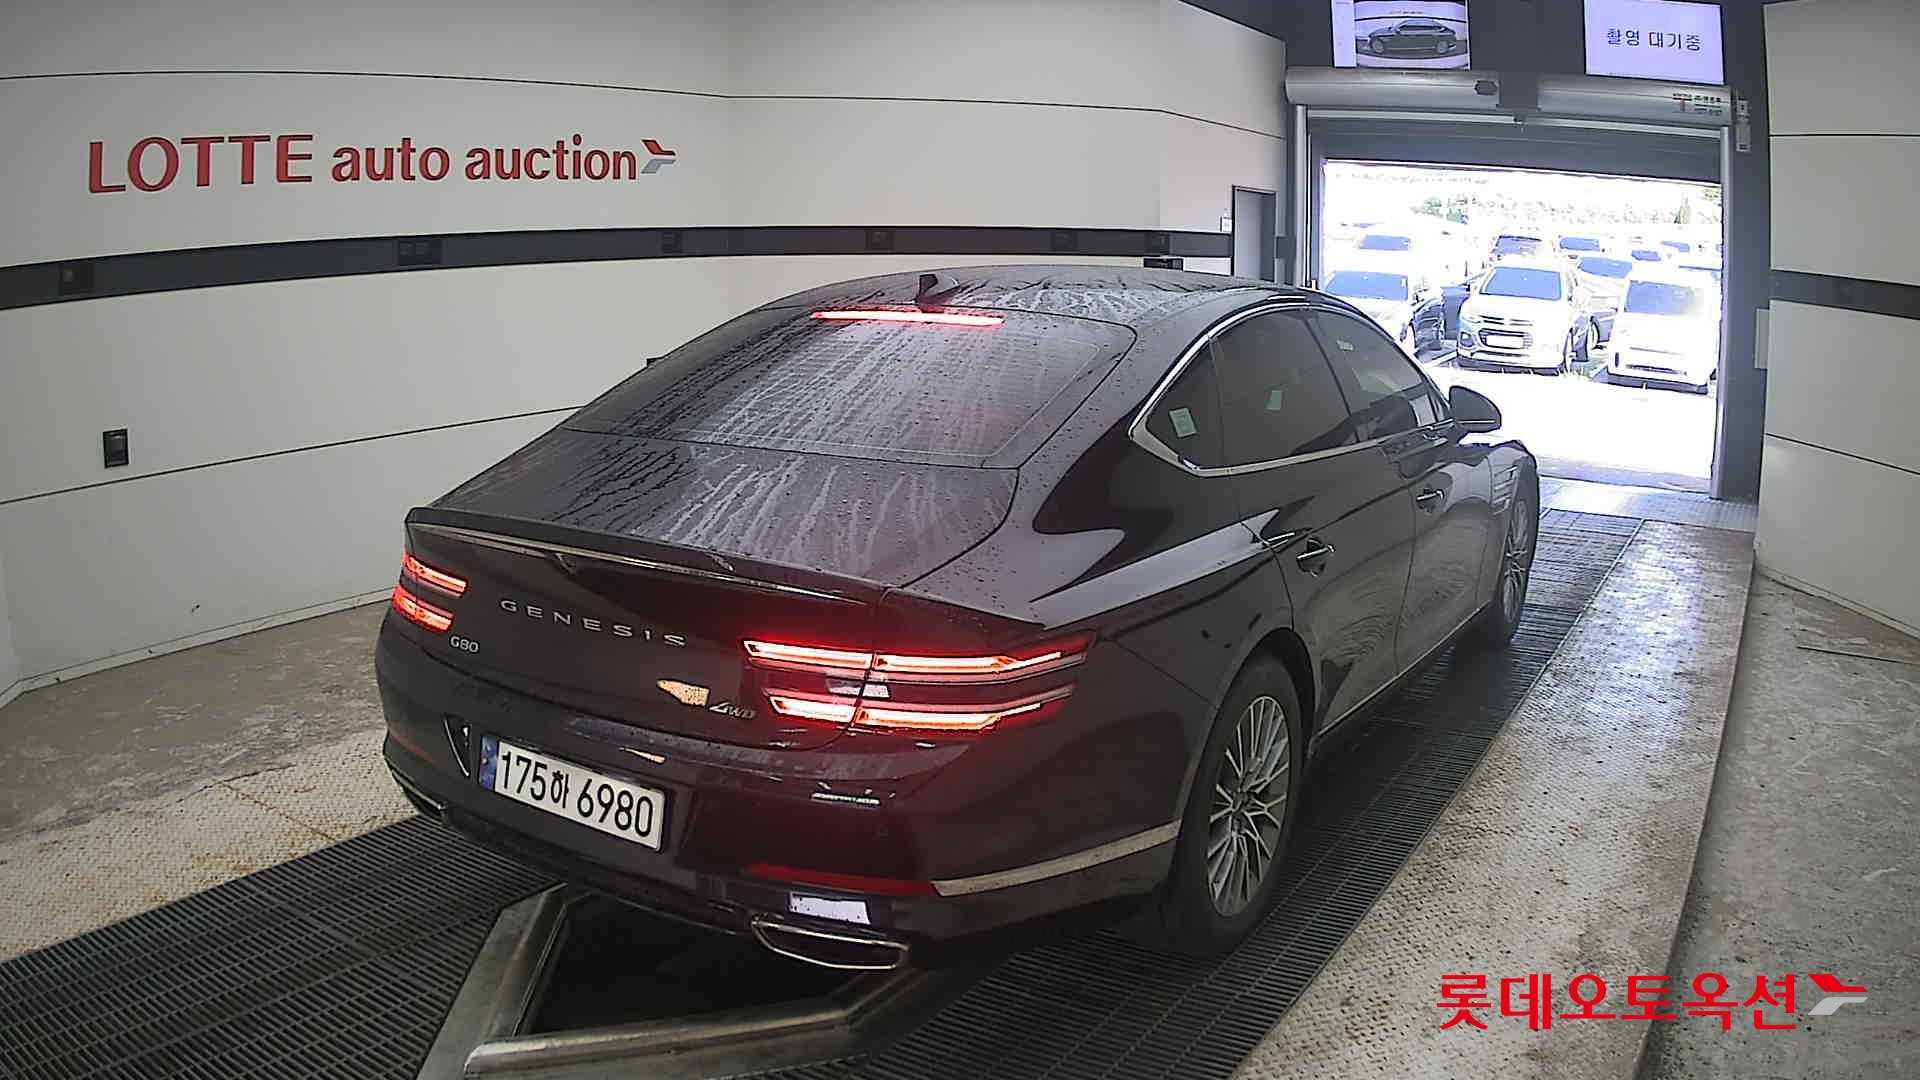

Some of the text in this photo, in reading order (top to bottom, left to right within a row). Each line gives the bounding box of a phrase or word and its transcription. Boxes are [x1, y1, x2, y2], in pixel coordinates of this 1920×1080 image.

[1607, 28, 1701, 51] 촬영 대기중
[88, 133, 637, 193] LOTTE auto auction
[450, 635, 479, 653] G80
[500, 600, 686, 646] GENESIS
[501, 751, 653, 837] 175하 6980
